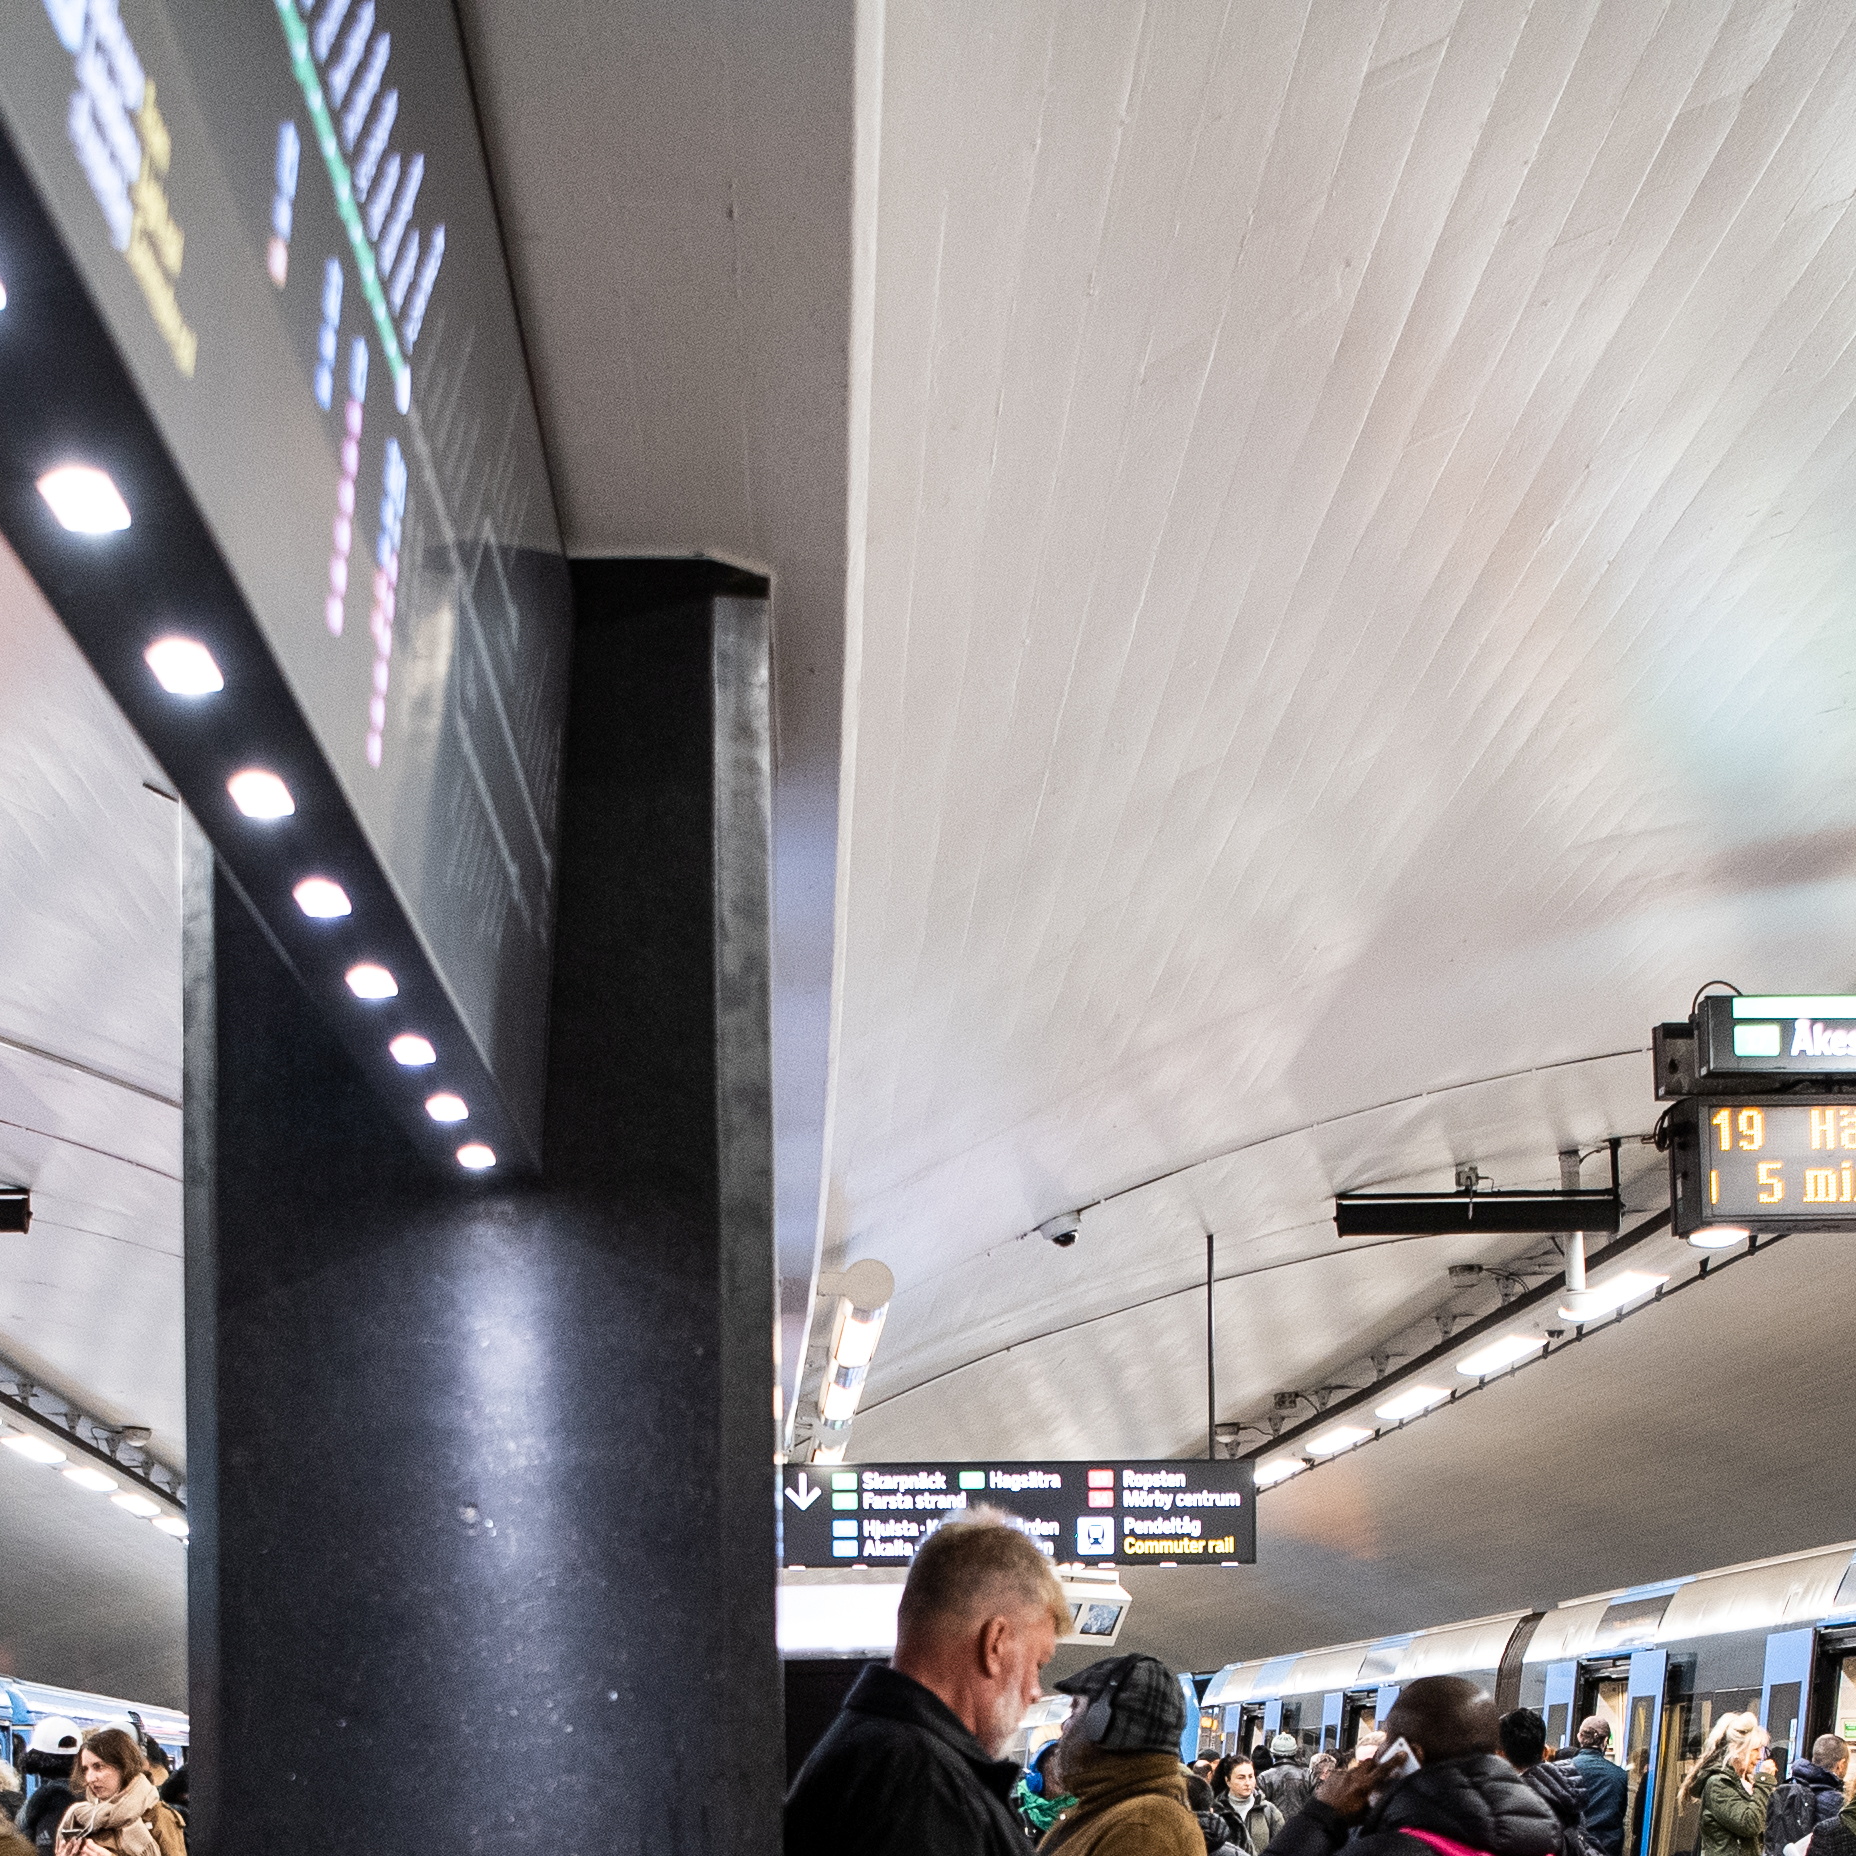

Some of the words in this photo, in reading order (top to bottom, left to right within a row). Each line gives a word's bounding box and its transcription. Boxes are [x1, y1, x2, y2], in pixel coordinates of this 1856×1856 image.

[1711, 1106, 1765, 1151] 19
[1756, 1160, 1785, 1203] 5
[861, 1470, 948, 1493] Skarpnäck
[988, 1469, 1063, 1492] Hagsätra
[1121, 1469, 1187, 1491] Ropsten
[862, 1490, 914, 1510] Farsta
[914, 1490, 968, 1510] strand
[1121, 1489, 1174, 1511] Mörby
[1175, 1489, 1242, 1508] centrum
[862, 1518, 920, 1540] Hjulsta
[1123, 1515, 1203, 1538] Pendeltåg
[862, 1538, 914, 1557] Akalla
[1123, 1535, 1207, 1555] Commuter
[1207, 1535, 1235, 1554] rail
